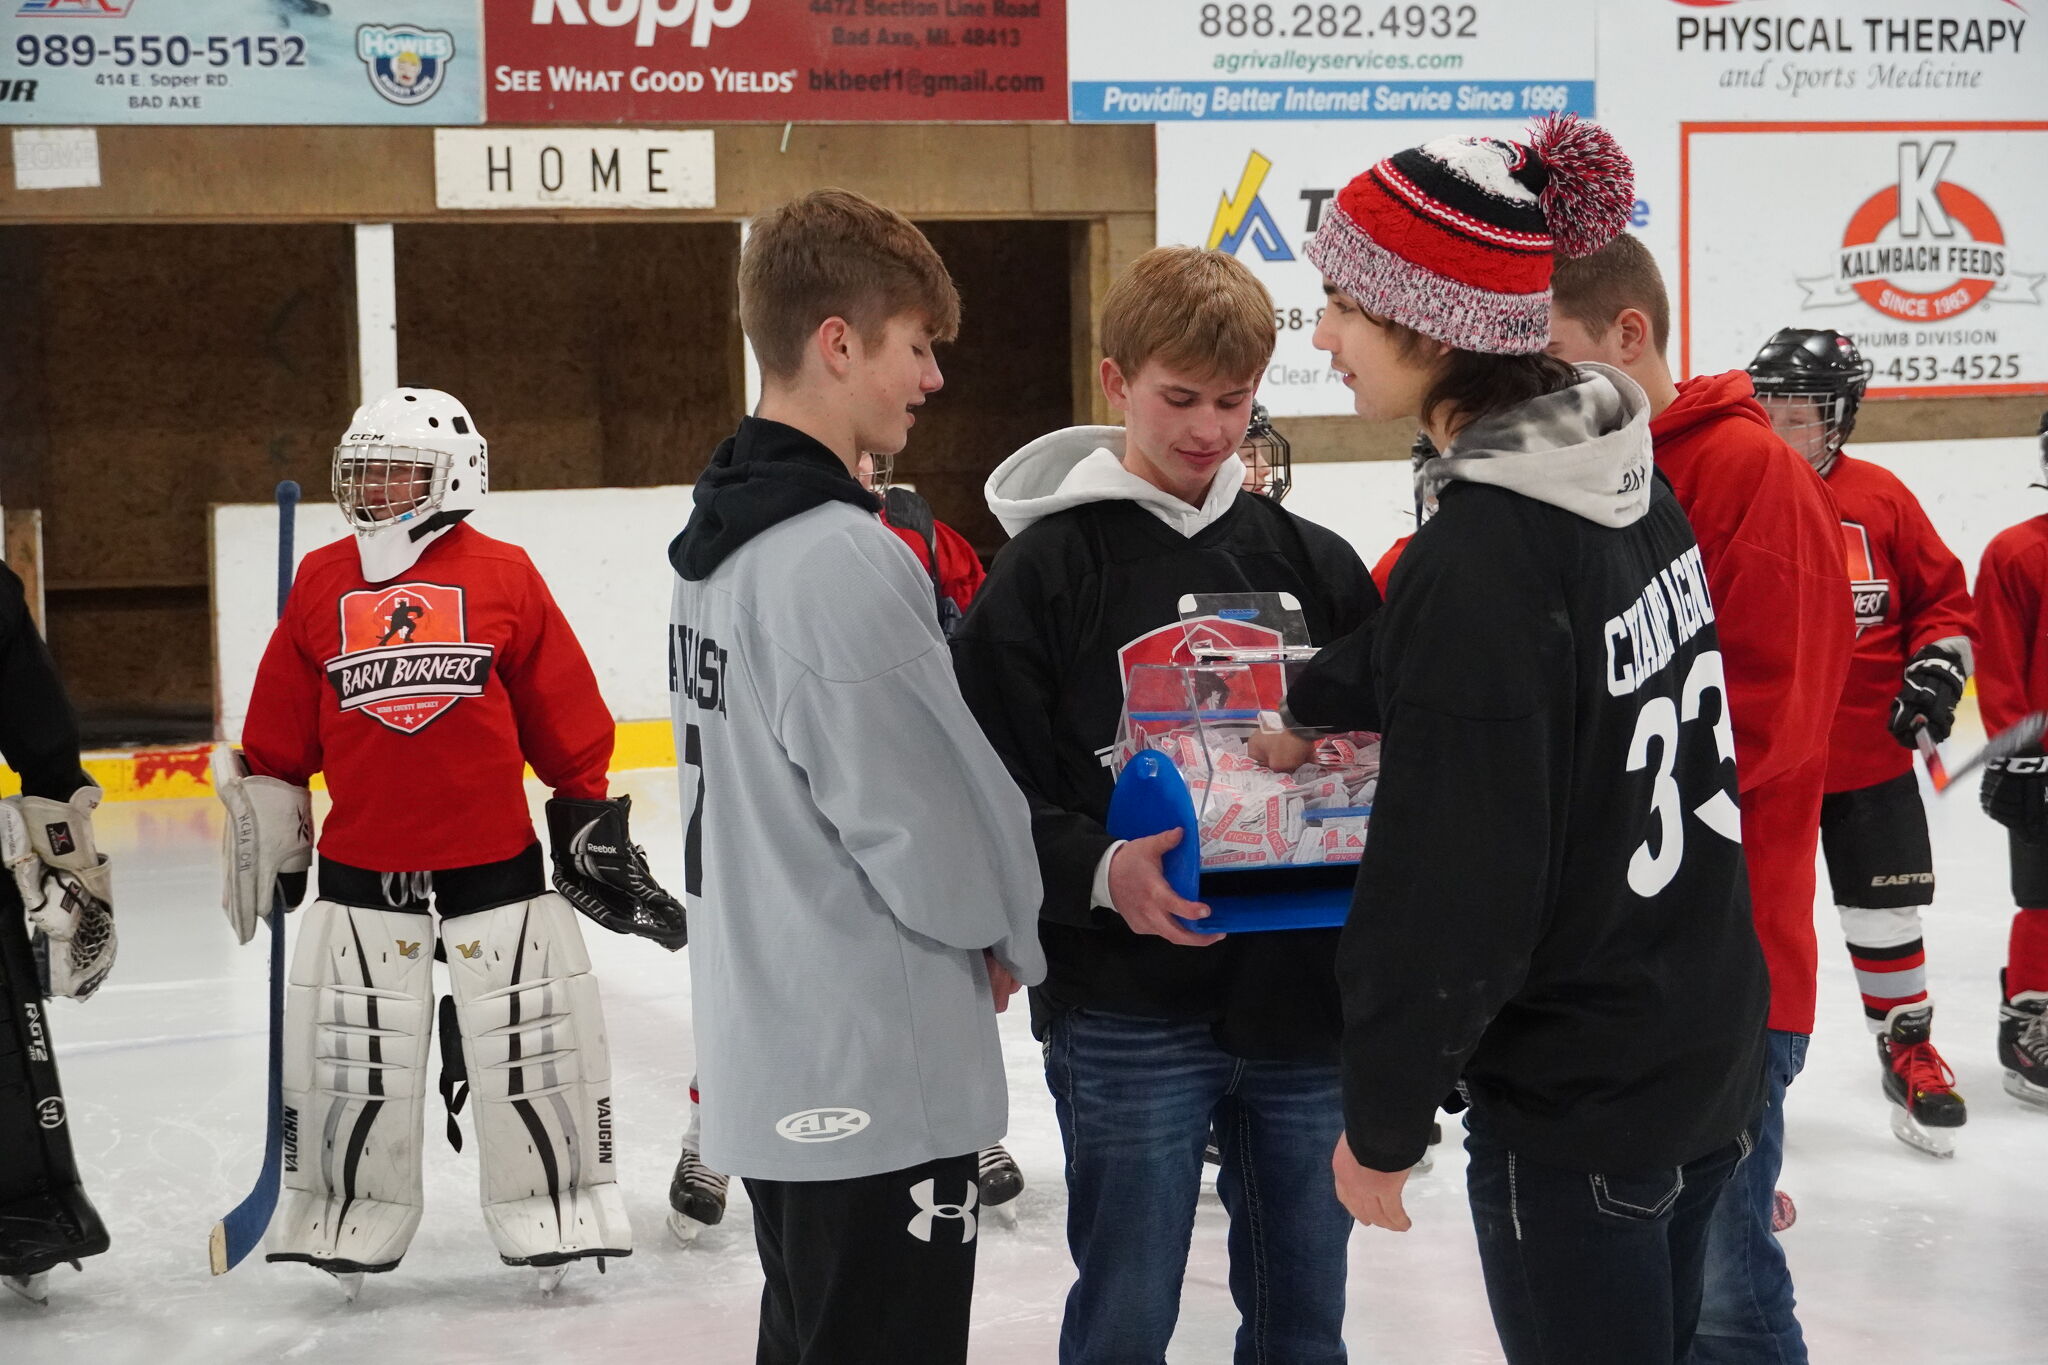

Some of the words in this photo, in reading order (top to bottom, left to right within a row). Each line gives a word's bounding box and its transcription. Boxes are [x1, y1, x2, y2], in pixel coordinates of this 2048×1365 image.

[1199, 4, 1478, 38] 888.282.4932
[1677, 16, 1852, 53] PHYSICAL
[1863, 18, 2026, 54] THERAPY
[16, 34, 306, 68] 989-550-5152
[832, 27, 869, 45] Bad
[962, 28, 1021, 47] 48413
[1213, 50, 1464, 74] agrivalleyservices.com
[1719, 57, 1772, 89] and
[1775, 61, 1857, 97] Sports
[1867, 62, 1983, 89] Medicine
[95, 74, 115, 86] 414
[150, 74, 201, 88] Soper
[494, 65, 542, 92] SEE
[547, 66, 624, 92] WHAT
[629, 66, 704, 92] GOOD
[808, 69, 1045, 97] bkbeef1@gmail.com
[129, 96, 163, 109] BAD
[169, 96, 202, 109] AXE
[1103, 86, 1207, 117] Providing
[1211, 86, 1282, 113] Better
[1284, 86, 1371, 113] Internet
[1374, 86, 1453, 112] Service
[1456, 86, 1515, 112] Since
[1520, 86, 1568, 111] 1996
[487, 145, 670, 193] HOME
[1898, 141, 1957, 238] K
[1841, 245, 1940, 280] KALMBACH
[1947, 247, 2006, 278] FEEDS
[1878, 287, 1929, 318] SINCE
[1915, 329, 1998, 347] DIVISION
[1267, 364, 1319, 386] Clear
[350, 433, 385, 441] CCM
[342, 659, 389, 697] BARN
[391, 655, 484, 688] BURNERS
[587, 843, 617, 854] Reebok
[1228, 832, 1262, 846] TICKET
[284, 1104, 299, 1172] VAUGHN
[596, 1095, 613, 1164] VAUGHN
